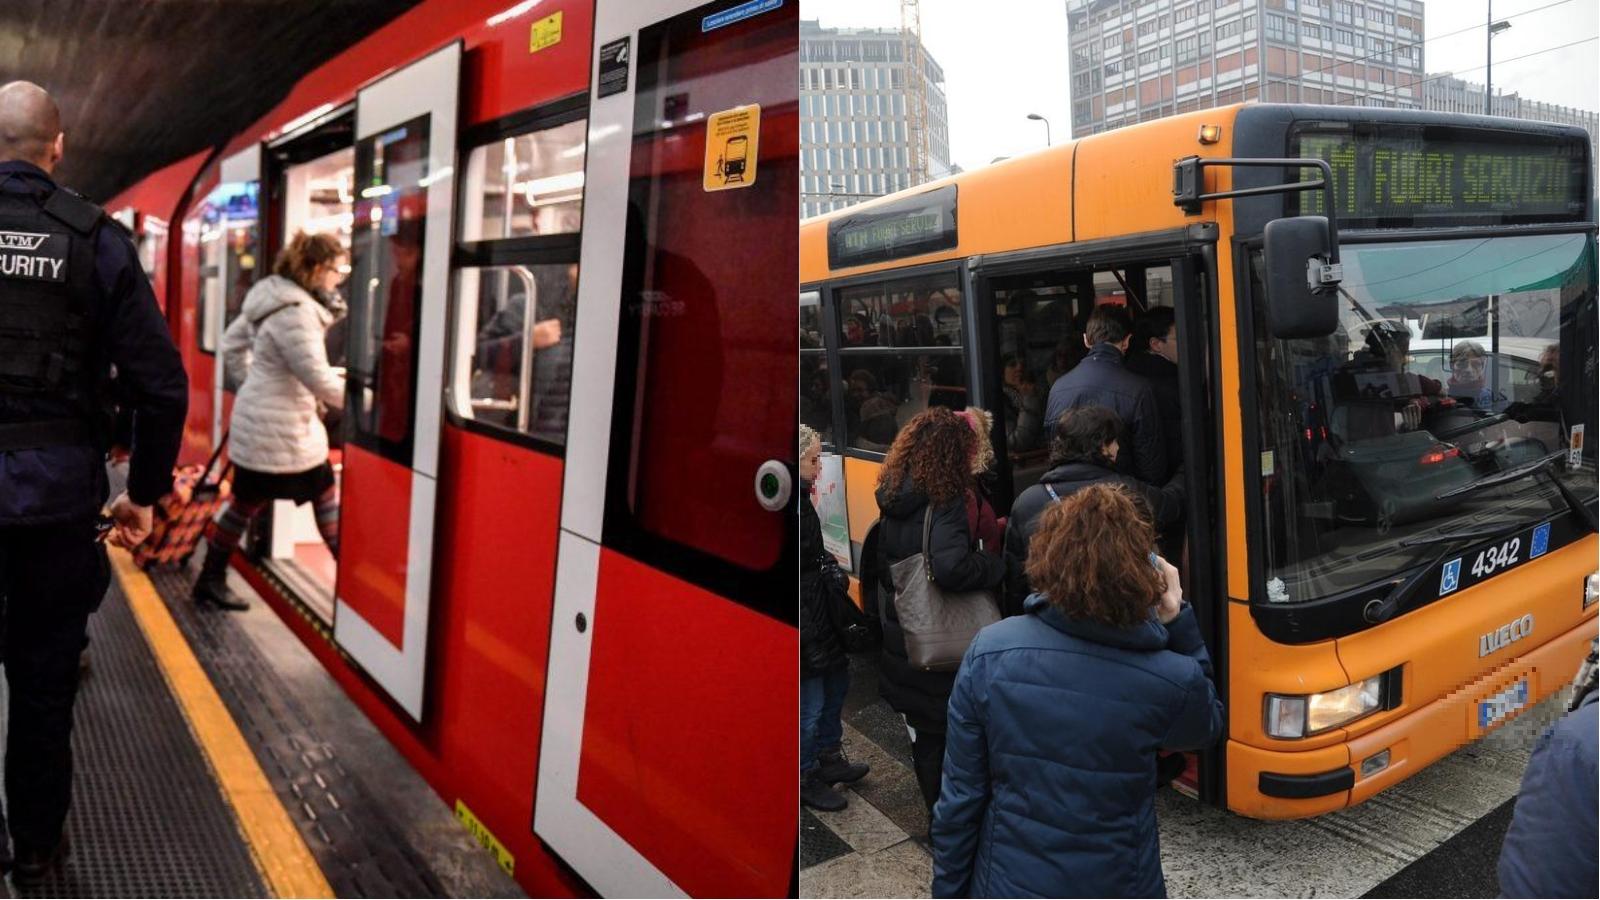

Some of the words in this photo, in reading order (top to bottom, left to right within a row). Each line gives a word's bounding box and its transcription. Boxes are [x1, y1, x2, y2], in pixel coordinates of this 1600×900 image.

[1375, 150, 1453, 204] FUORI
[0, 254, 63, 279] URITY
[1471, 537, 1520, 577] 4342
[1479, 613, 1535, 657] IVECO
